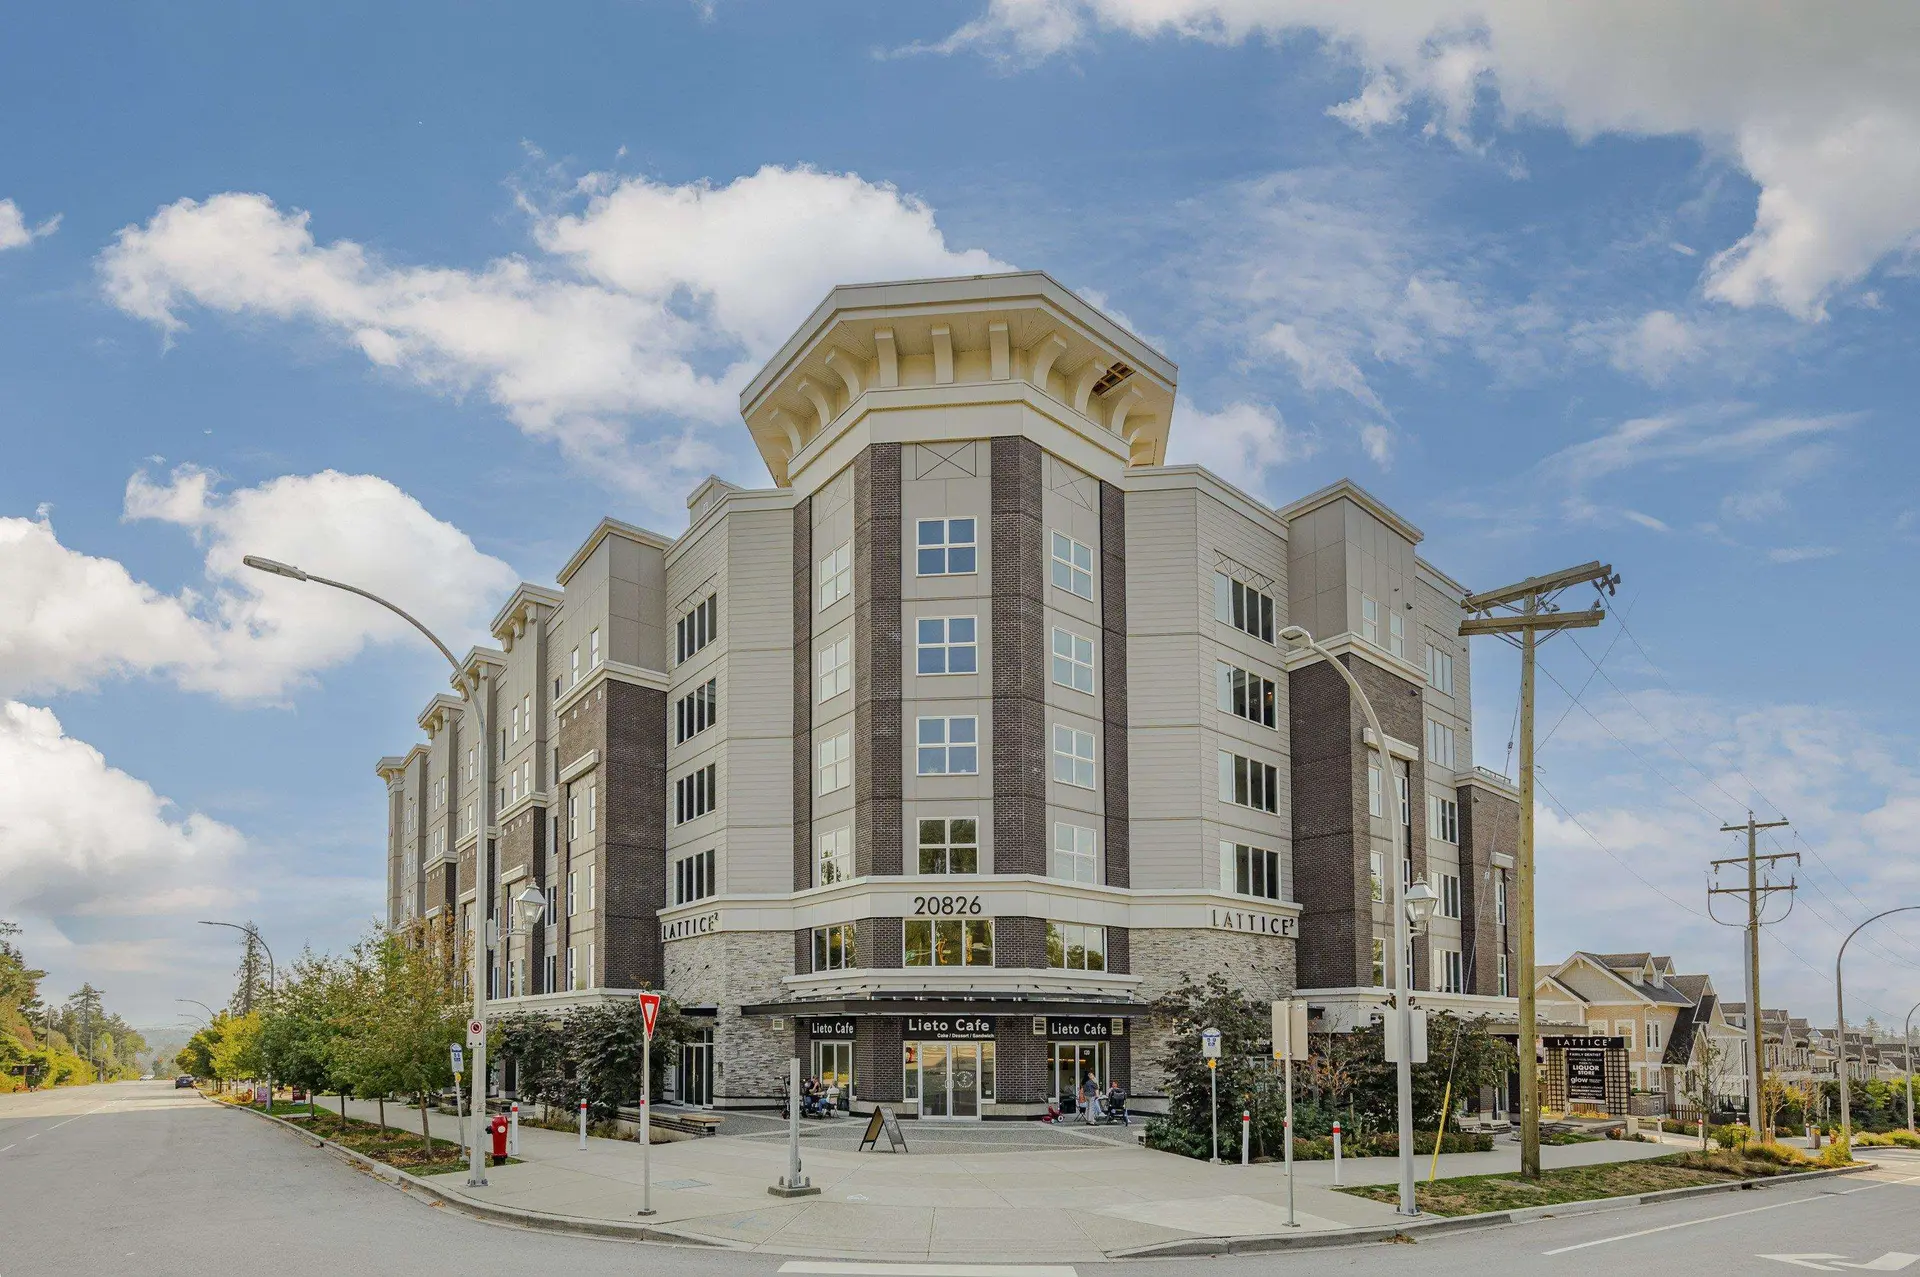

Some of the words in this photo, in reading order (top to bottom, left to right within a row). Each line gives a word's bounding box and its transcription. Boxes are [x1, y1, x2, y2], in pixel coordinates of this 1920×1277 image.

[914, 895, 981, 915] 20826
[812, 1022, 832, 1033] Lieto
[835, 1022, 854, 1033] Cafe
[908, 1019, 948, 1031] Lieto
[955, 1019, 990, 1031] Cafe
[1051, 1022, 1080, 1034] Lieto
[1083, 1022, 1107, 1034] Cafe
